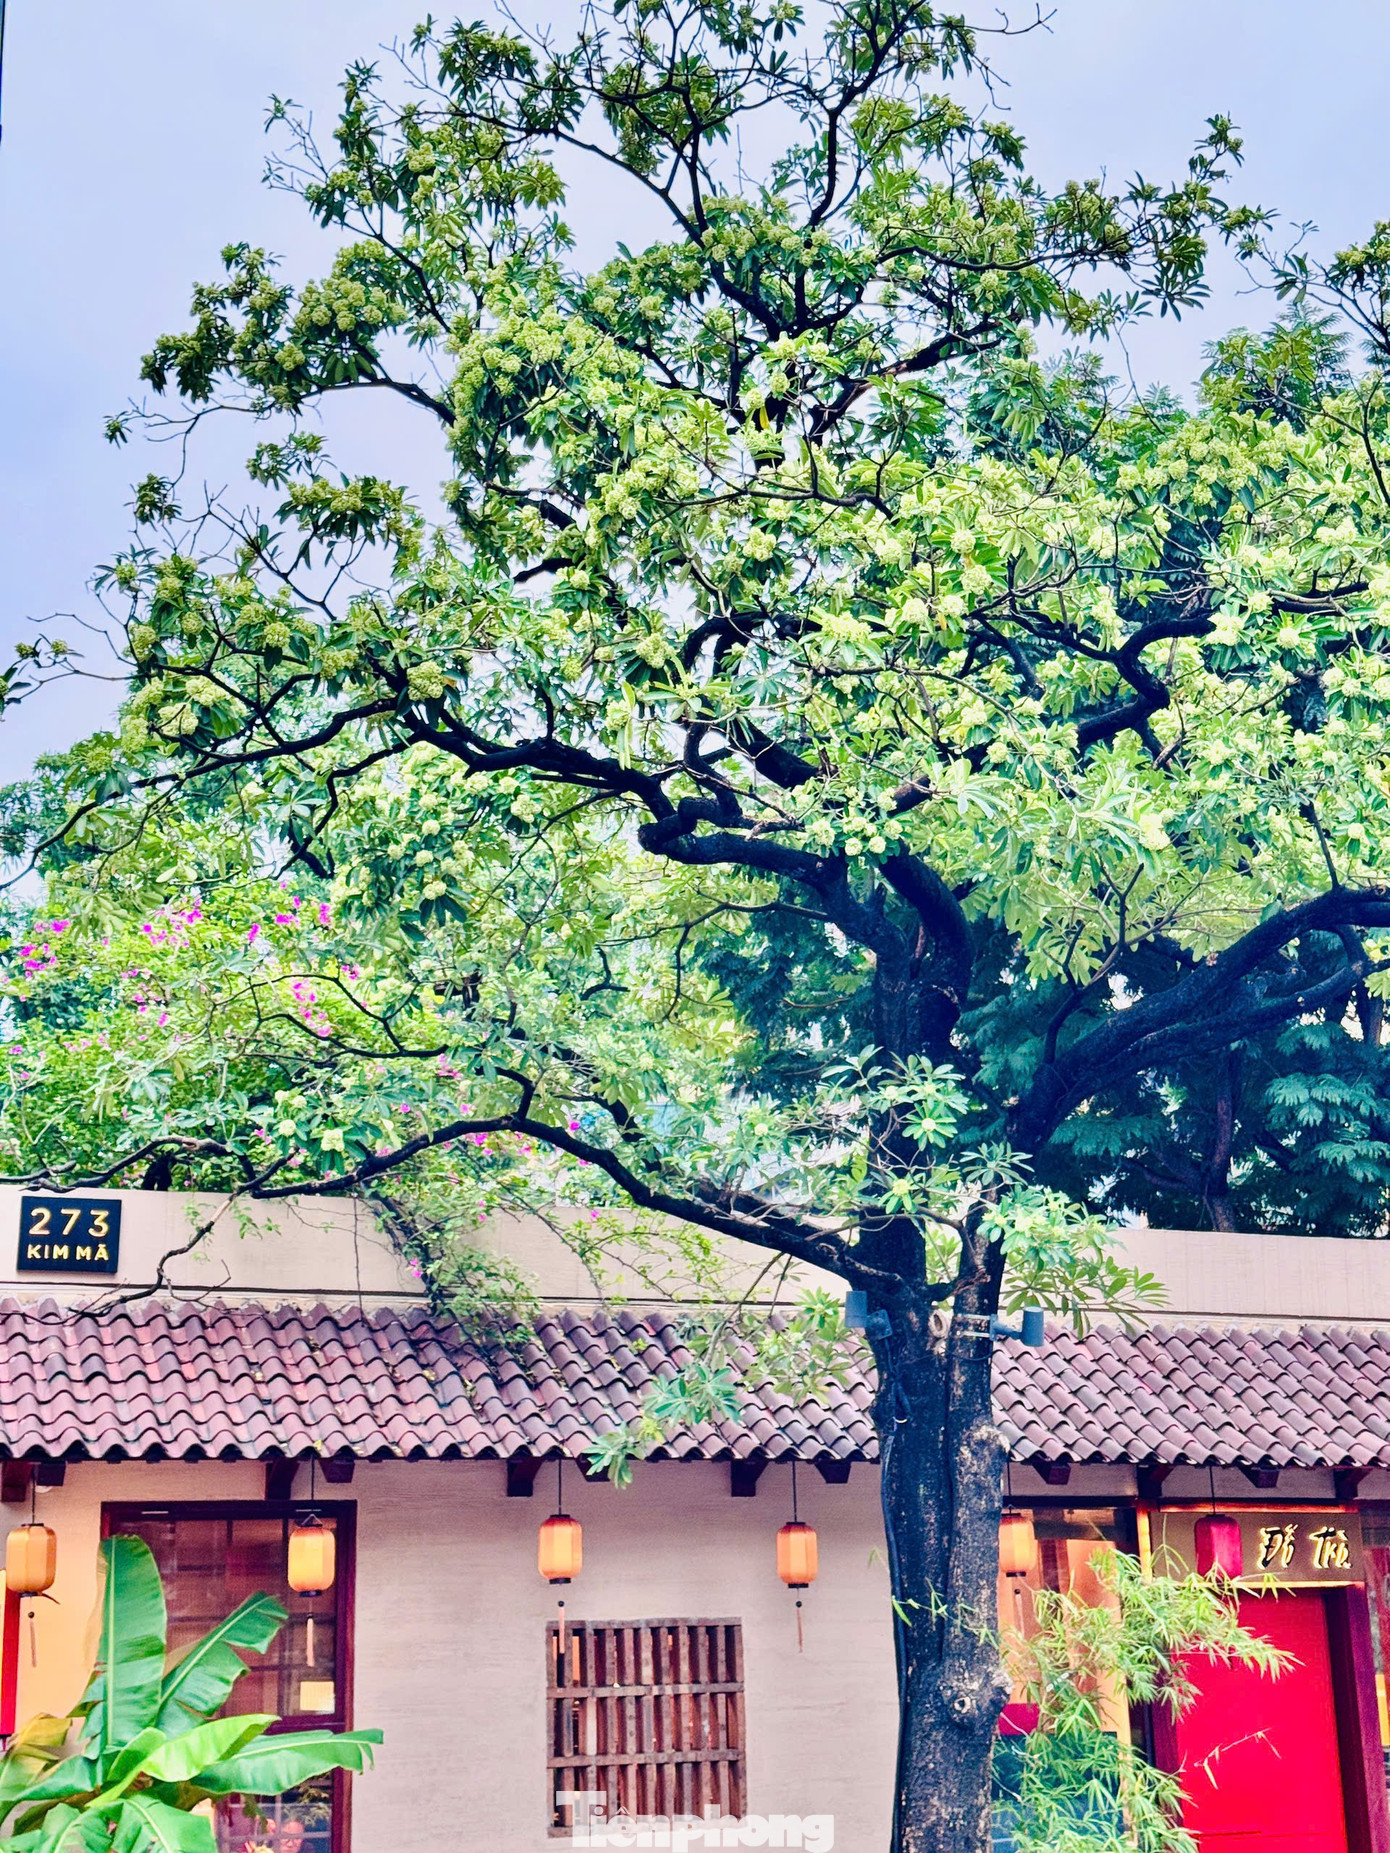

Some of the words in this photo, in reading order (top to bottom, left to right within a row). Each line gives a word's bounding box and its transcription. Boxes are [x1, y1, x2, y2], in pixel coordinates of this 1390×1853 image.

[28, 1207, 109, 1237] 273
[26, 1243, 69, 1260] KIM
[75, 1243, 109, 1261] MÃ
